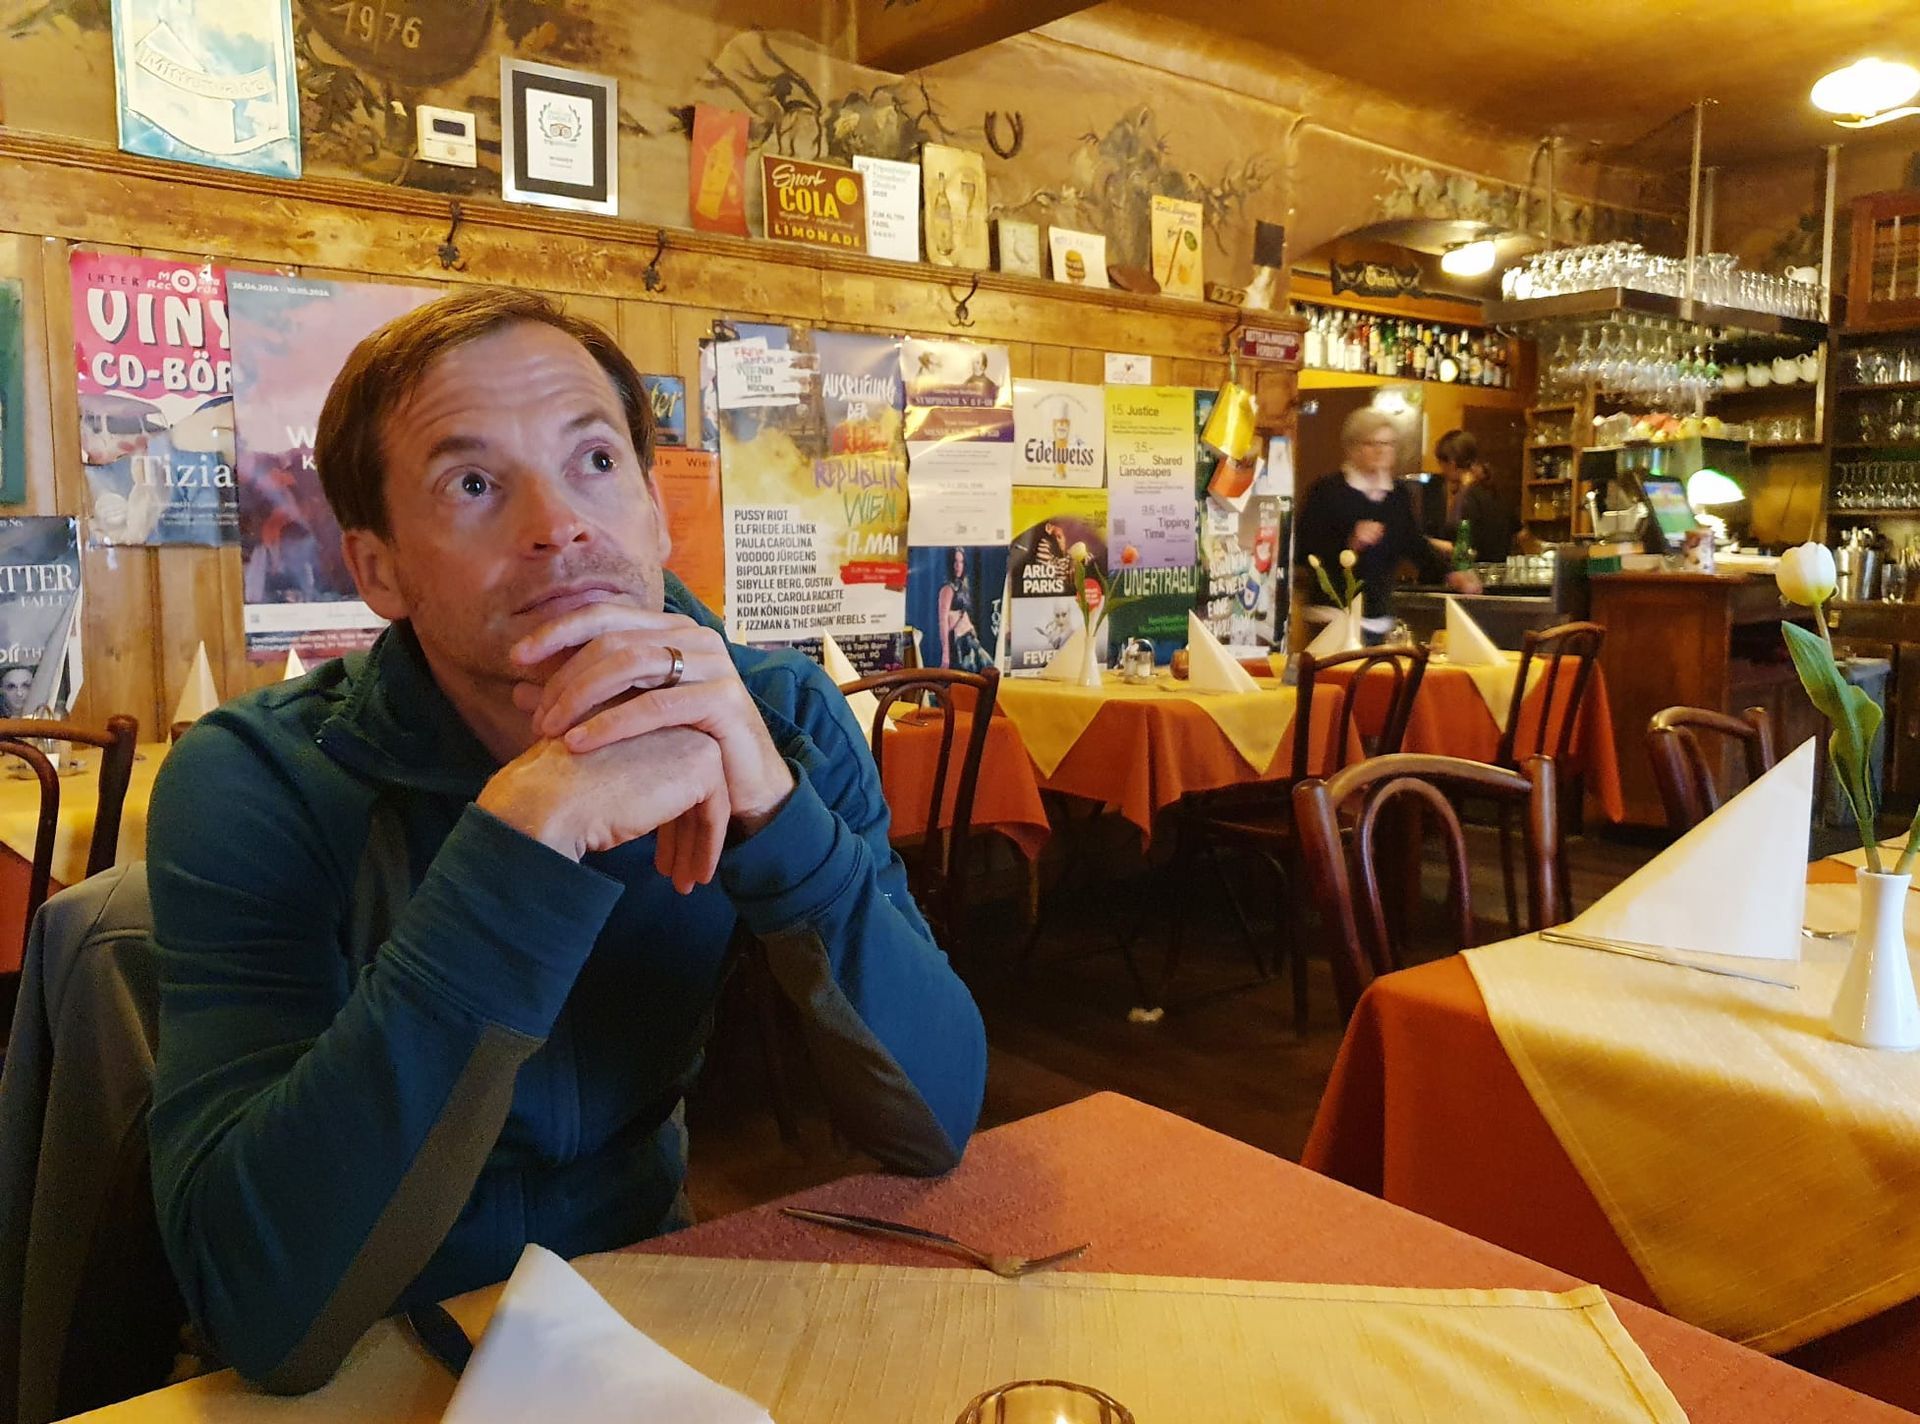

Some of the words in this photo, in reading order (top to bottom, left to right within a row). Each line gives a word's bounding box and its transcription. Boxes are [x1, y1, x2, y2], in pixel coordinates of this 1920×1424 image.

[771, 163, 827, 188] Sport
[779, 187, 840, 220] COLA
[774, 223, 861, 248] LIMONADE
[88, 272, 140, 287] INTER
[1127, 405, 1160, 417] Justice
[1025, 438, 1094, 466] Edelweiss
[1151, 454, 1183, 466] Shared
[133, 452, 235, 488] Tizia
[815, 458, 903, 495] REPUBLIK
[1119, 466, 1172, 478] Landscapes
[734, 509, 765, 521] PUSSY
[767, 509, 788, 521] RIOT
[843, 489, 897, 528] WIEN
[735, 523, 781, 535] ELFRIEDE
[782, 523, 817, 535] JELINEK
[1157, 517, 1190, 529] Tipping
[1143, 528, 1166, 539] Time
[735, 537, 766, 549] PAULA
[767, 537, 813, 549] CAROLINA
[864, 532, 899, 556] MAI
[736, 551, 775, 563] VOODOO
[776, 549, 817, 562] JÜRGENS
[736, 565, 778, 577] BIPOLAR
[779, 564, 817, 576] FEMININ
[1023, 563, 1056, 579] ARLO
[0, 563, 75, 594] TTER
[736, 579, 773, 590] SIBYLLE
[777, 578, 804, 590] BERG,
[805, 577, 834, 588] GUSTAV
[1023, 578, 1064, 594] PARKS
[737, 593, 754, 604] KID
[755, 592, 776, 604] PEX,
[777, 590, 812, 602] CAROLA
[812, 589, 845, 600] RACKETE
[760, 604, 799, 617] KÖNIGIN
[800, 603, 816, 615] DER
[816, 602, 842, 614] MACHT
[784, 619, 791, 630] &
[793, 618, 809, 629] THE
[836, 614, 866, 625] REBELS
